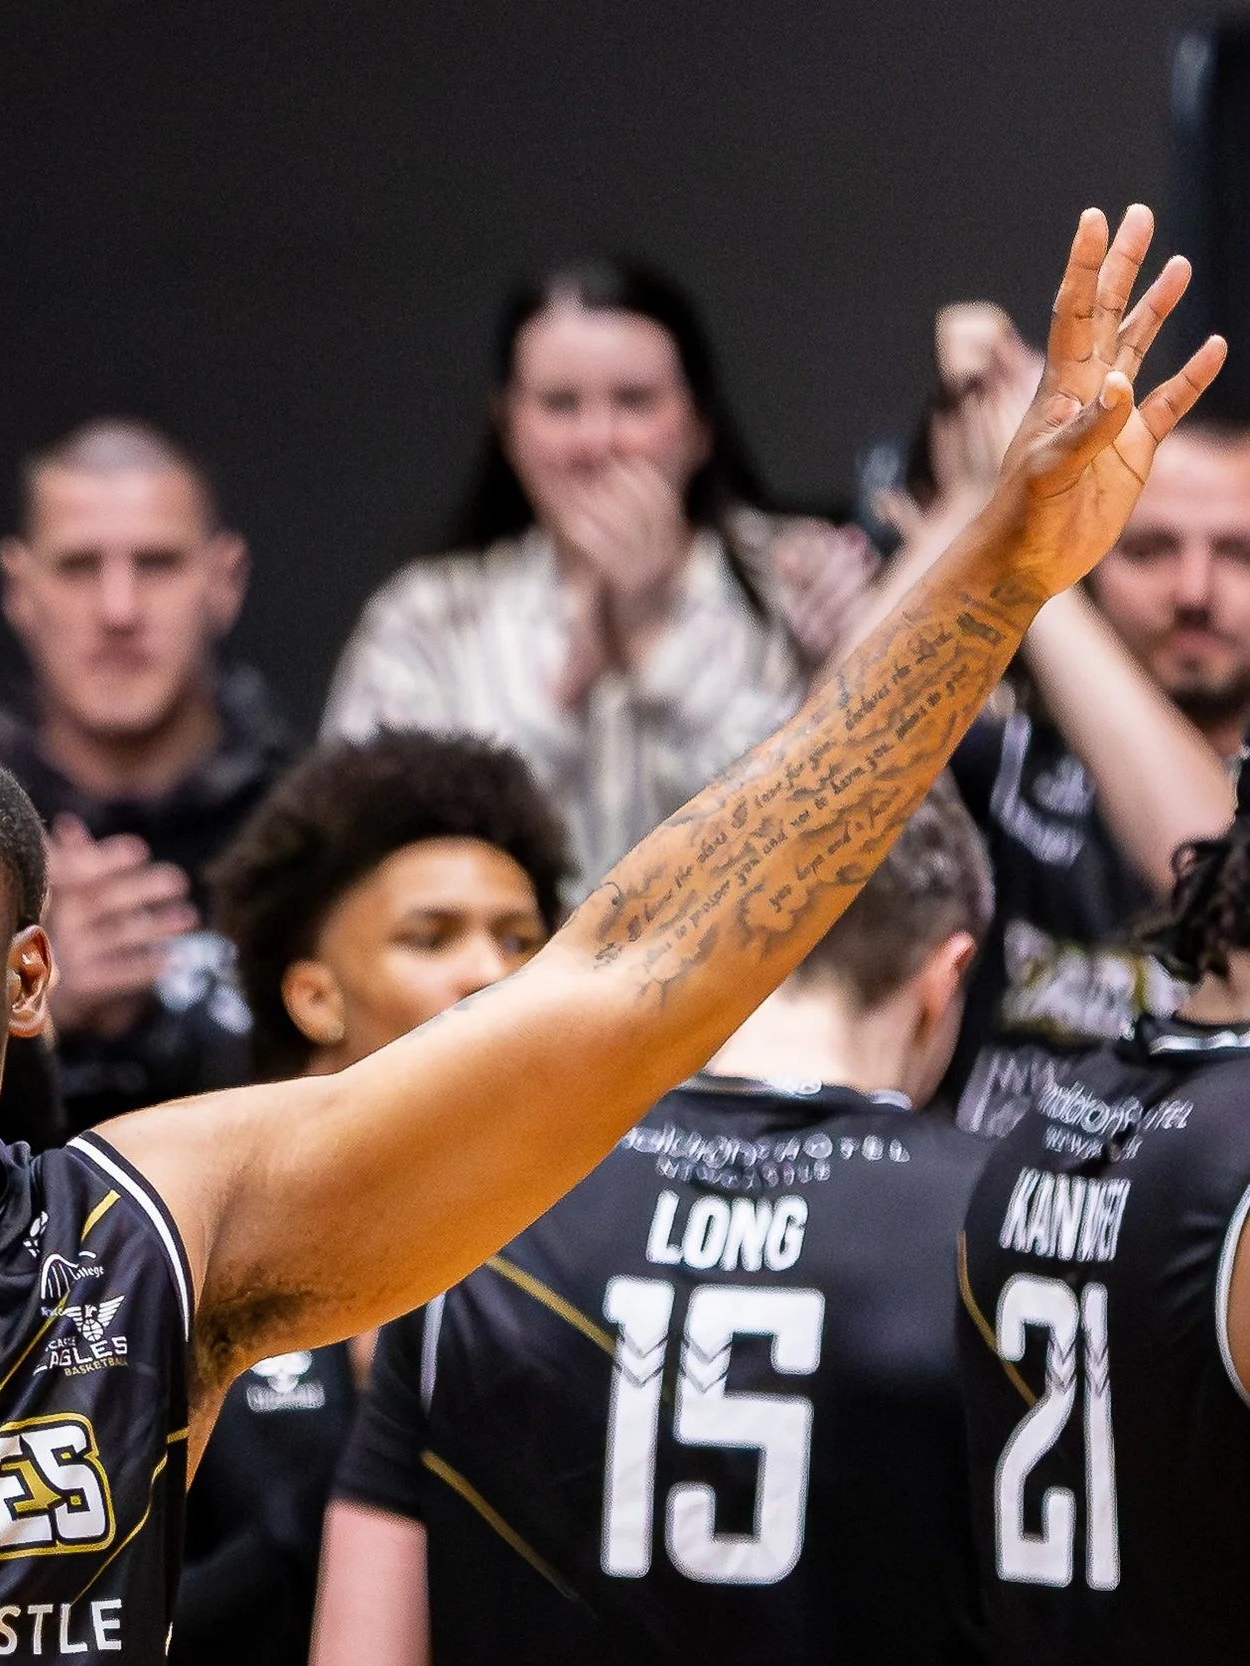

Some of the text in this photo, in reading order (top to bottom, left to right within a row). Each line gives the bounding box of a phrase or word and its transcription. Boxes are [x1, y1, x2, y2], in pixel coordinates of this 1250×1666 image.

[646, 1190, 808, 1272] LONG
[33, 1335, 128, 1375] AGLES
[601, 1275, 825, 1585] 15
[996, 1272, 1120, 1591] 21
